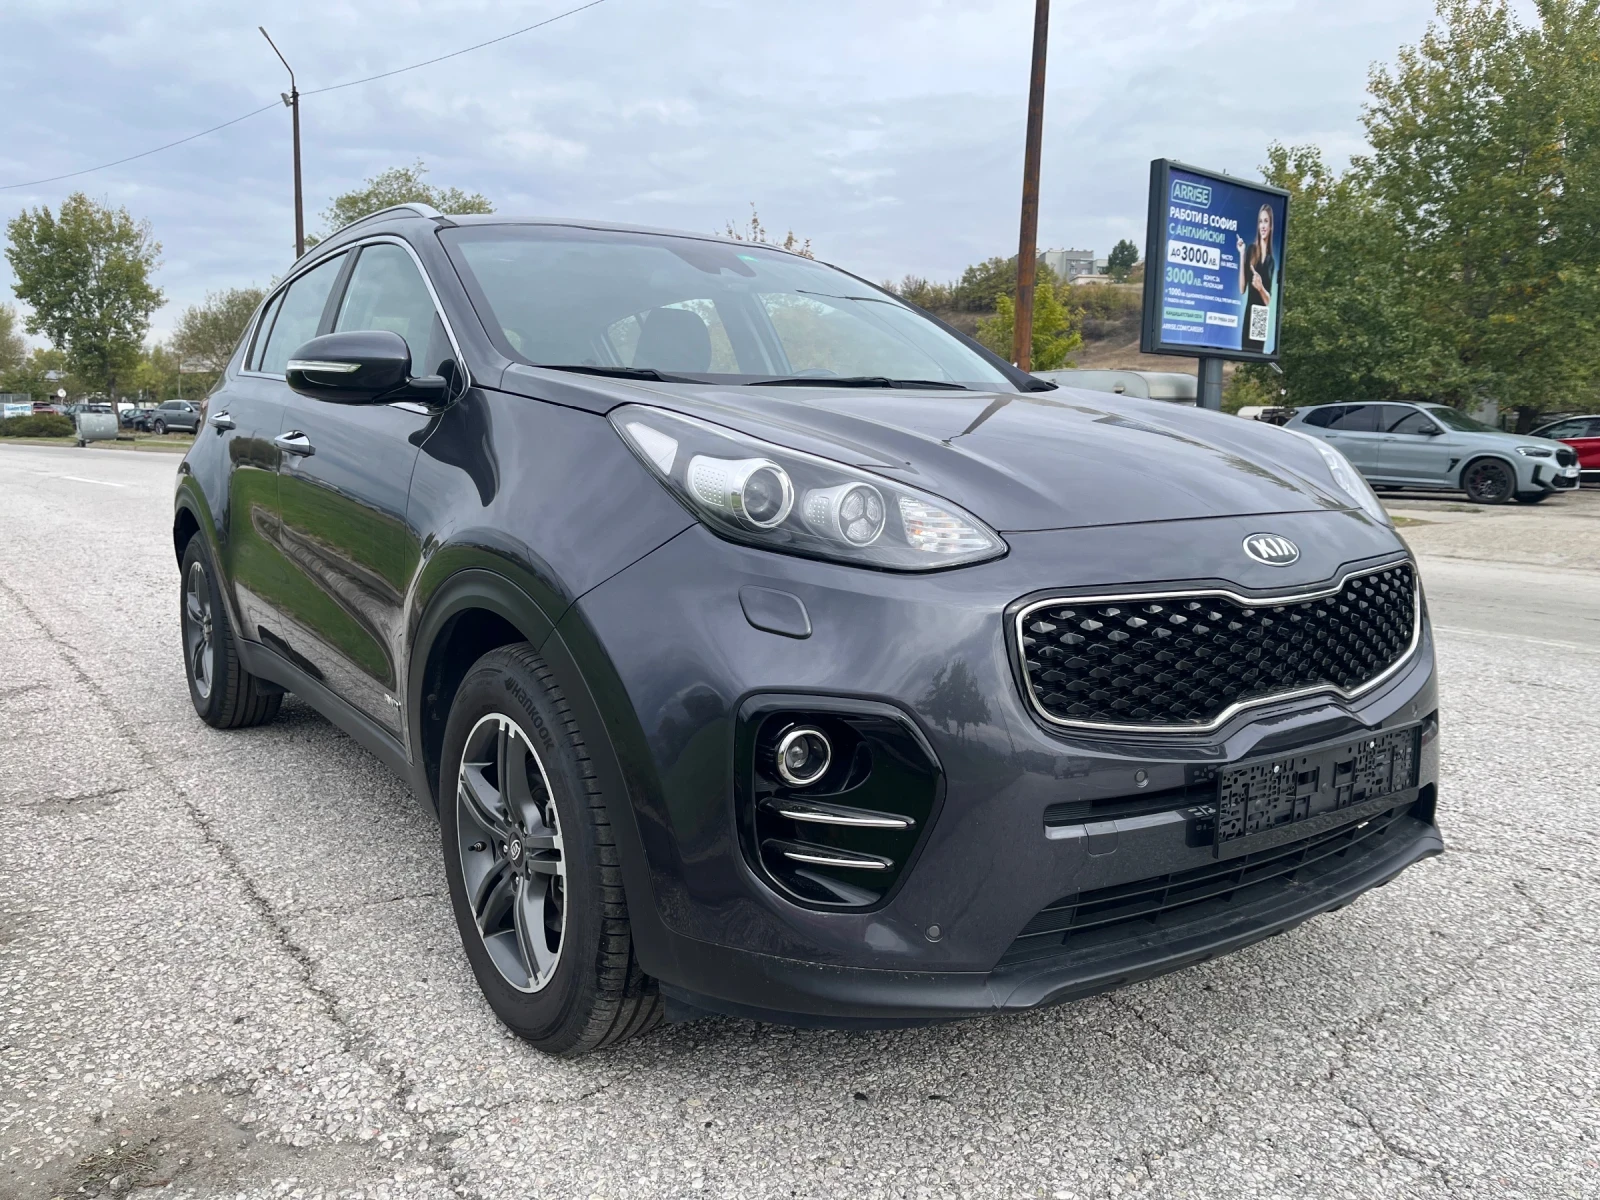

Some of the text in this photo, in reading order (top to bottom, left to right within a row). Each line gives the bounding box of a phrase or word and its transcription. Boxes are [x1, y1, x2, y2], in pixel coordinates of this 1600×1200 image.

[1173, 184, 1210, 204] ARRISE
[1170, 207, 1237, 231] РАБОТИ В СОФИЯ
[1169, 223, 1226, 244] С АНГЛИЙСКИ!
[1181, 246, 1209, 265] 3000
[1166, 267, 1194, 285] 3000
[1250, 538, 1296, 558] KIA
